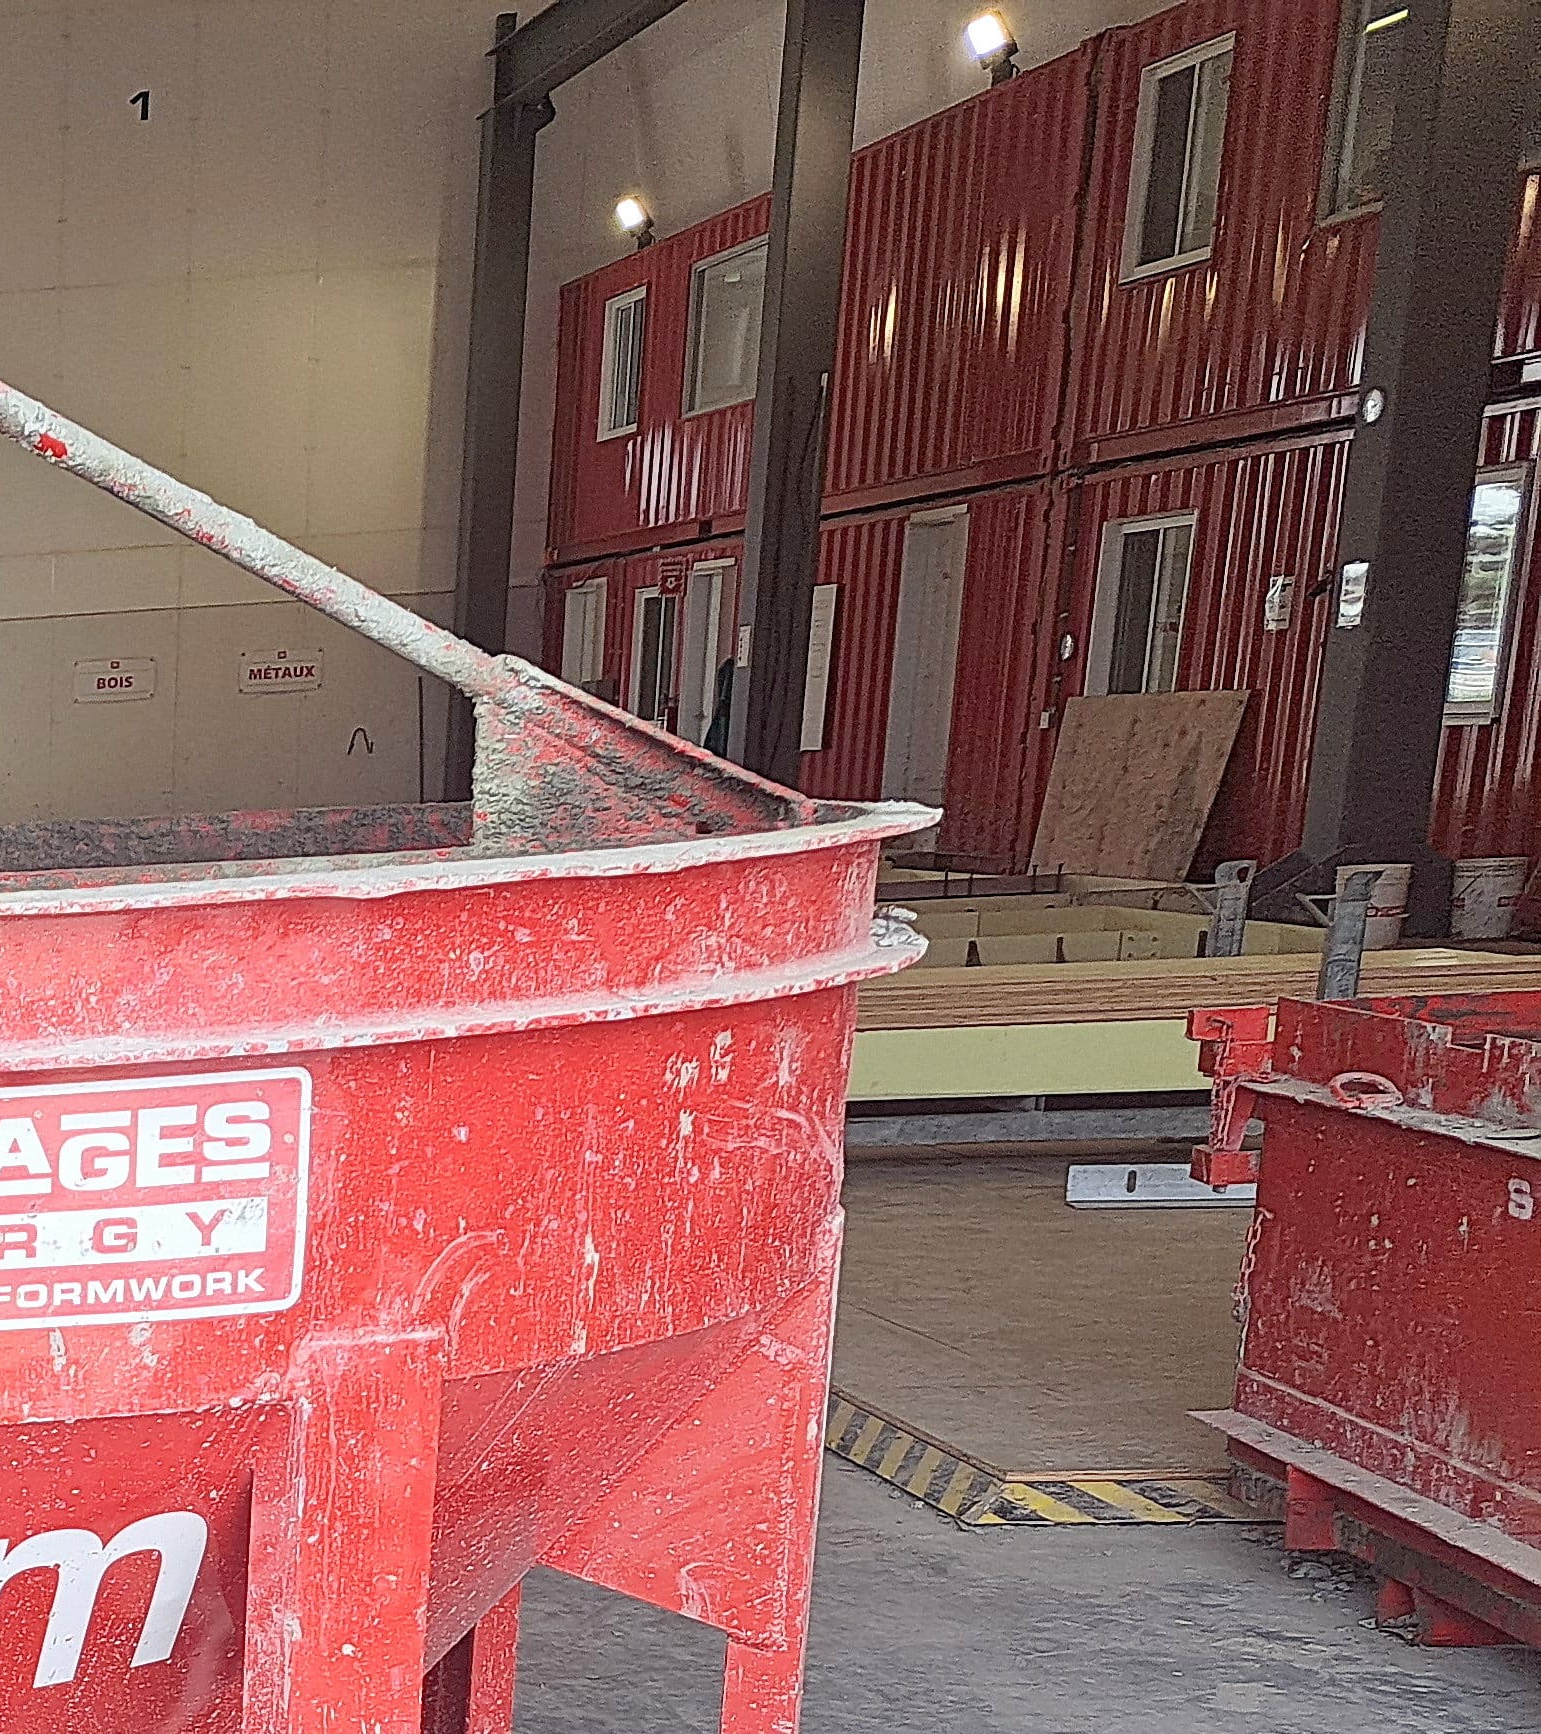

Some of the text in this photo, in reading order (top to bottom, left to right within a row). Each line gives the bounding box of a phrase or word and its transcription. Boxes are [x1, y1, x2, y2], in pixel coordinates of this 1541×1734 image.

[129, 91, 150, 120] 1
[248, 665, 316, 681] MÉTAUX
[97, 676, 134, 690] BOIS
